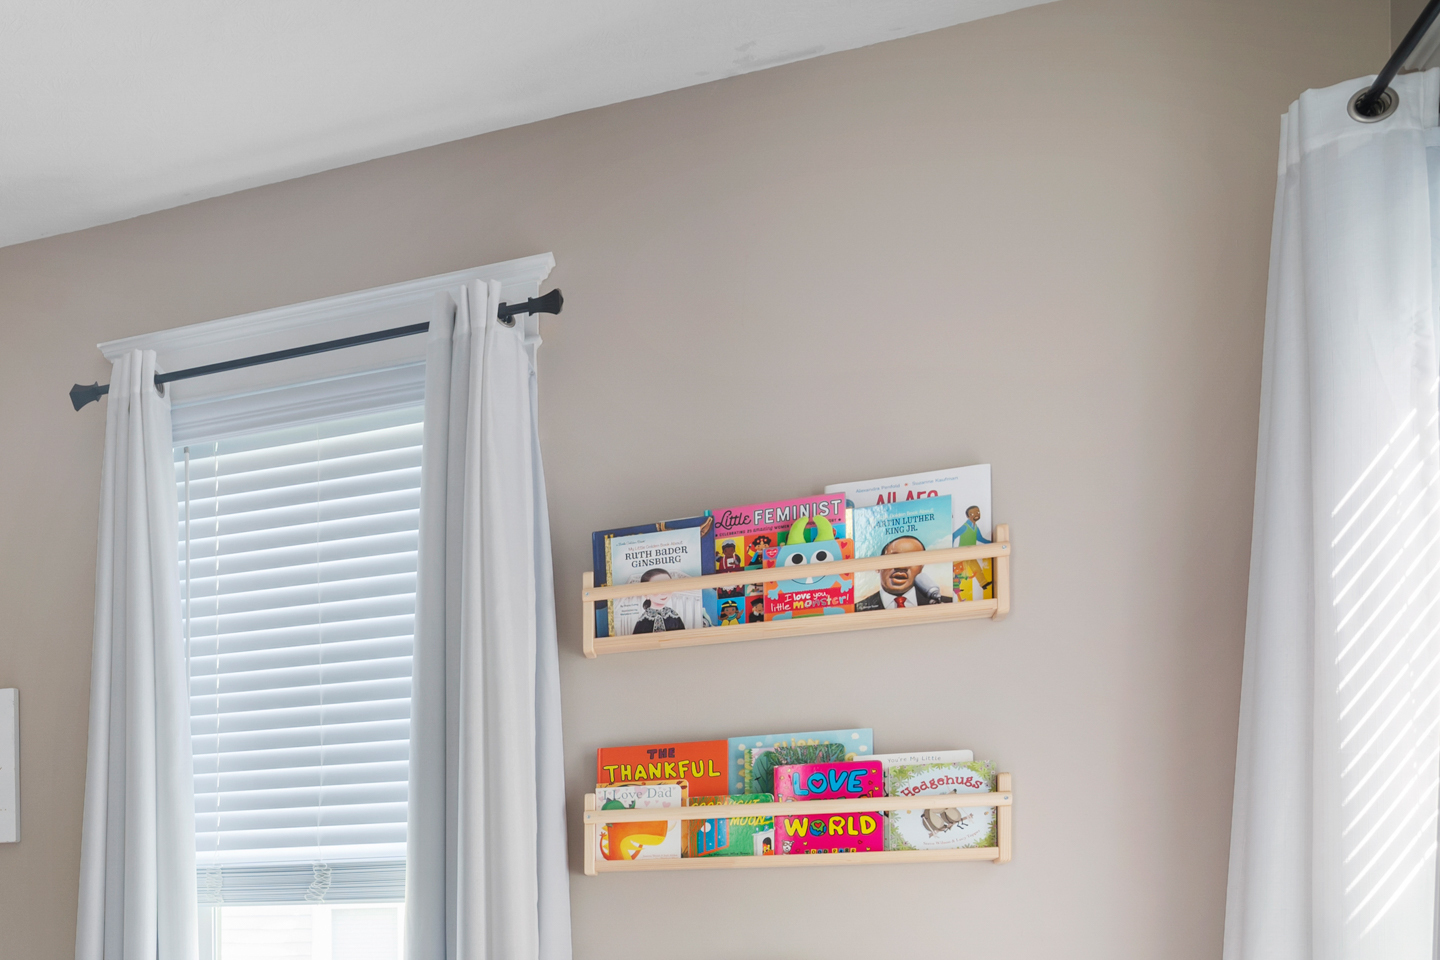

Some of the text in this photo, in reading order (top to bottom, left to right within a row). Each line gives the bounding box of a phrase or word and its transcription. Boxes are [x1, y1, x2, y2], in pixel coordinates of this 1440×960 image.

[715, 499, 842, 530] Little FEMINIST
[902, 513, 936, 525] LUTHER
[885, 524, 918, 536] KING JR.
[770, 602, 792, 612] little
[793, 594, 849, 610] monster!
[785, 594, 792, 603] I
[793, 592, 811, 601] love
[647, 747, 676, 760] THE
[603, 759, 721, 783] THANKFUL
[792, 769, 868, 796] LOVE
[900, 775, 983, 797] Hedgehugs
[612, 789, 643, 801] Love
[647, 787, 673, 799] Dad
[784, 815, 877, 837] WORLD
